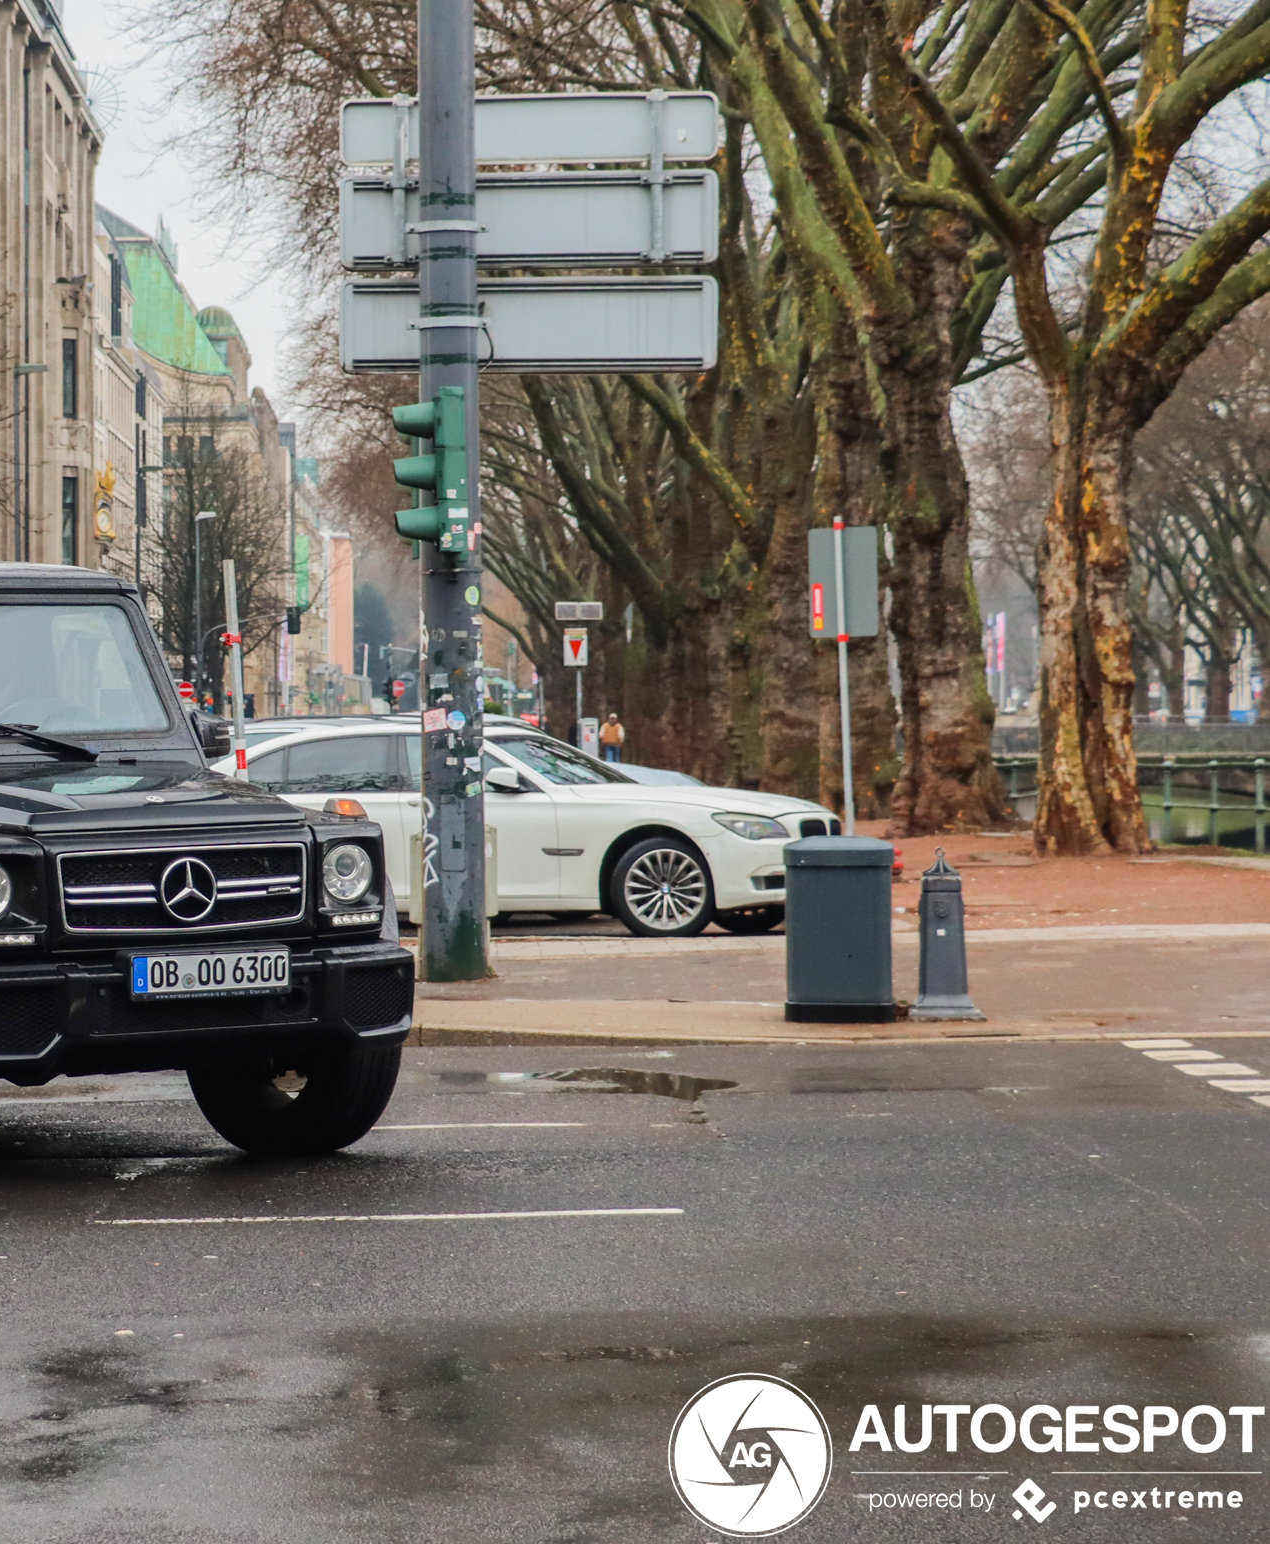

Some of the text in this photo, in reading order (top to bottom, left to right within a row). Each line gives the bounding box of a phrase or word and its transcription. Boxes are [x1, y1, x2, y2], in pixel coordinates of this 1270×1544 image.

[137, 978, 144, 987] D
[150, 959, 179, 988] OB
[232, 954, 286, 985] 6300
